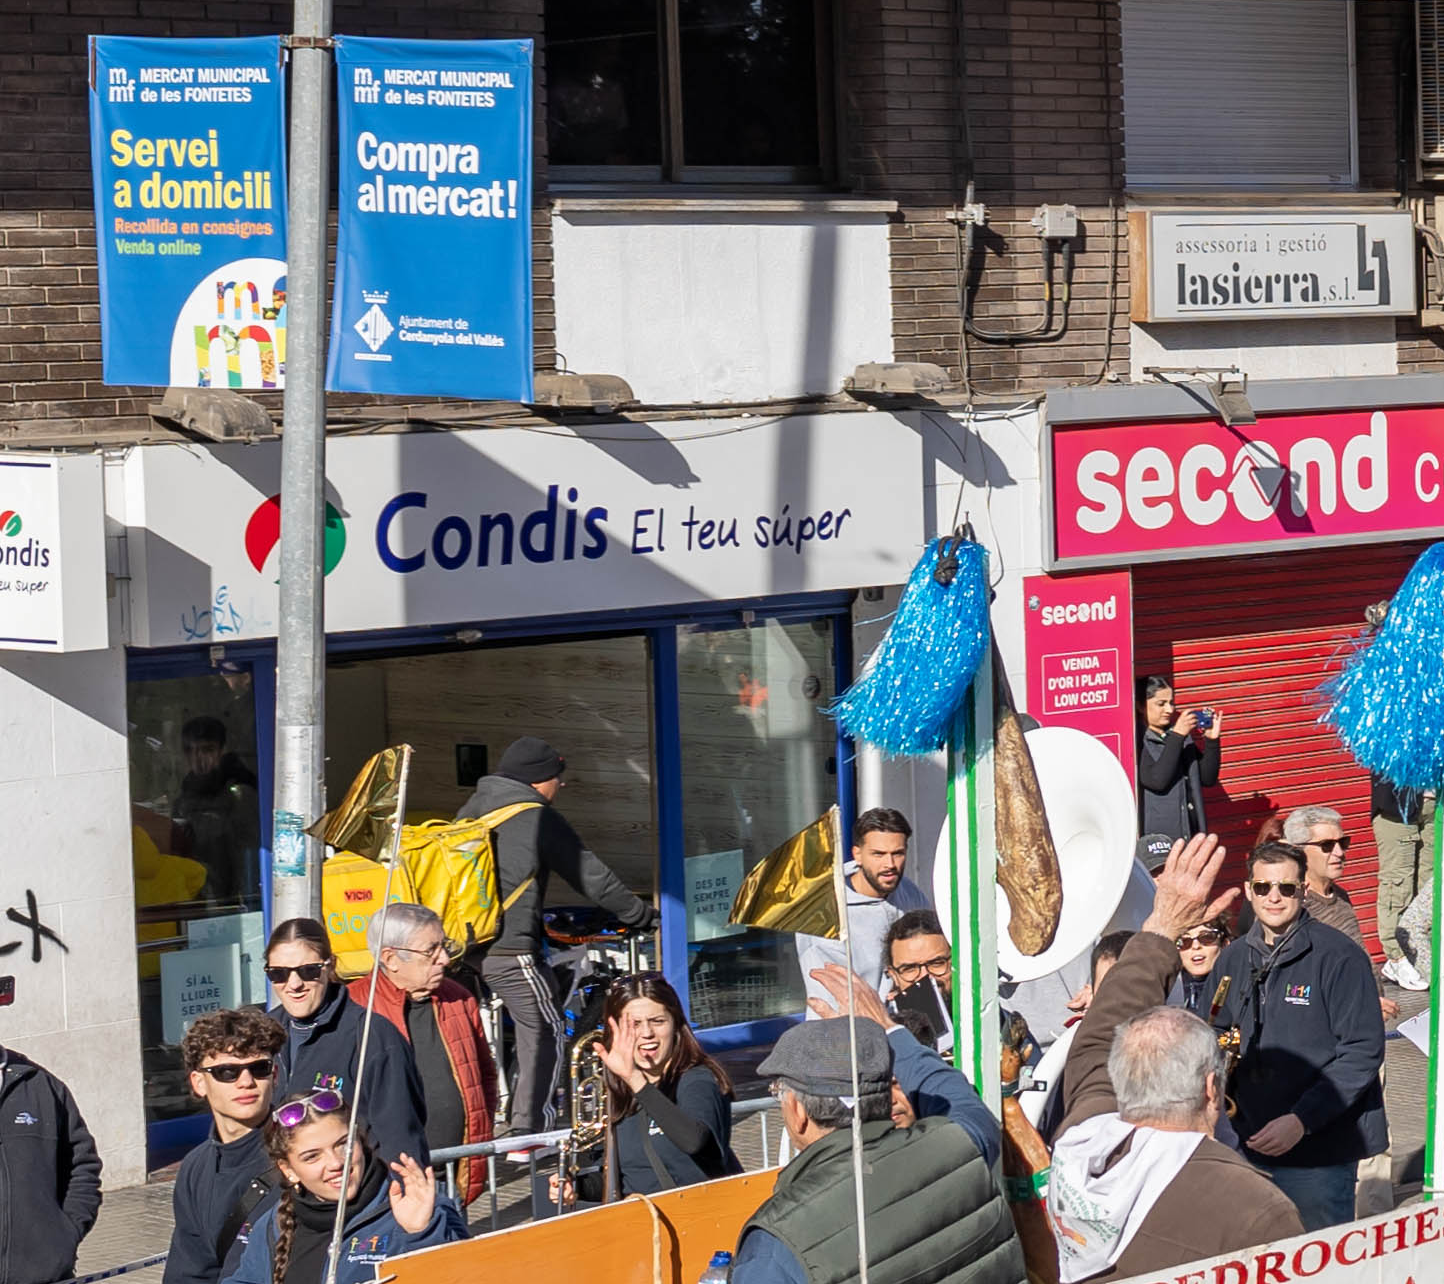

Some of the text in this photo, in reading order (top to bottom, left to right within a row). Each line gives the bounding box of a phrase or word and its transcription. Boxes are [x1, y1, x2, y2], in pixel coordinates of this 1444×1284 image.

[140, 68, 270, 83] MERCAT MUNICIPAL
[384, 69, 514, 88] MERCAT MUNICIPAL
[140, 87, 252, 103] de les FONTETES
[384, 90, 495, 107] de les FONTETES
[110, 129, 219, 167] Servei
[357, 131, 480, 181] Compra
[114, 171, 272, 209] a domicili
[357, 175, 517, 219] al mercat!
[115, 218, 273, 239] Recollida en consignes
[115, 239, 201, 256] Venda online
[1175, 233, 1327, 255] assessoria i gestió
[399, 315, 469, 329] Ajuntament de
[399, 330, 454, 346] Cerdanyola
[456, 333, 473, 345] del
[1075, 411, 1388, 535] second
[375, 484, 852, 574] Condis El teu súper
[1041, 595, 1116, 626] second
[1062, 656, 1100, 672] VENDA
[1048, 672, 1114, 691] D'OR I PLATA
[1054, 690, 1109, 708] LOW COST
[696, 877, 727, 890] DES DE
[693, 891, 730, 904] SEMPRE
[696, 902, 729, 915] AMB TU
[200, 974, 214, 985] AL
[181, 988, 220, 1002] LLIURE
